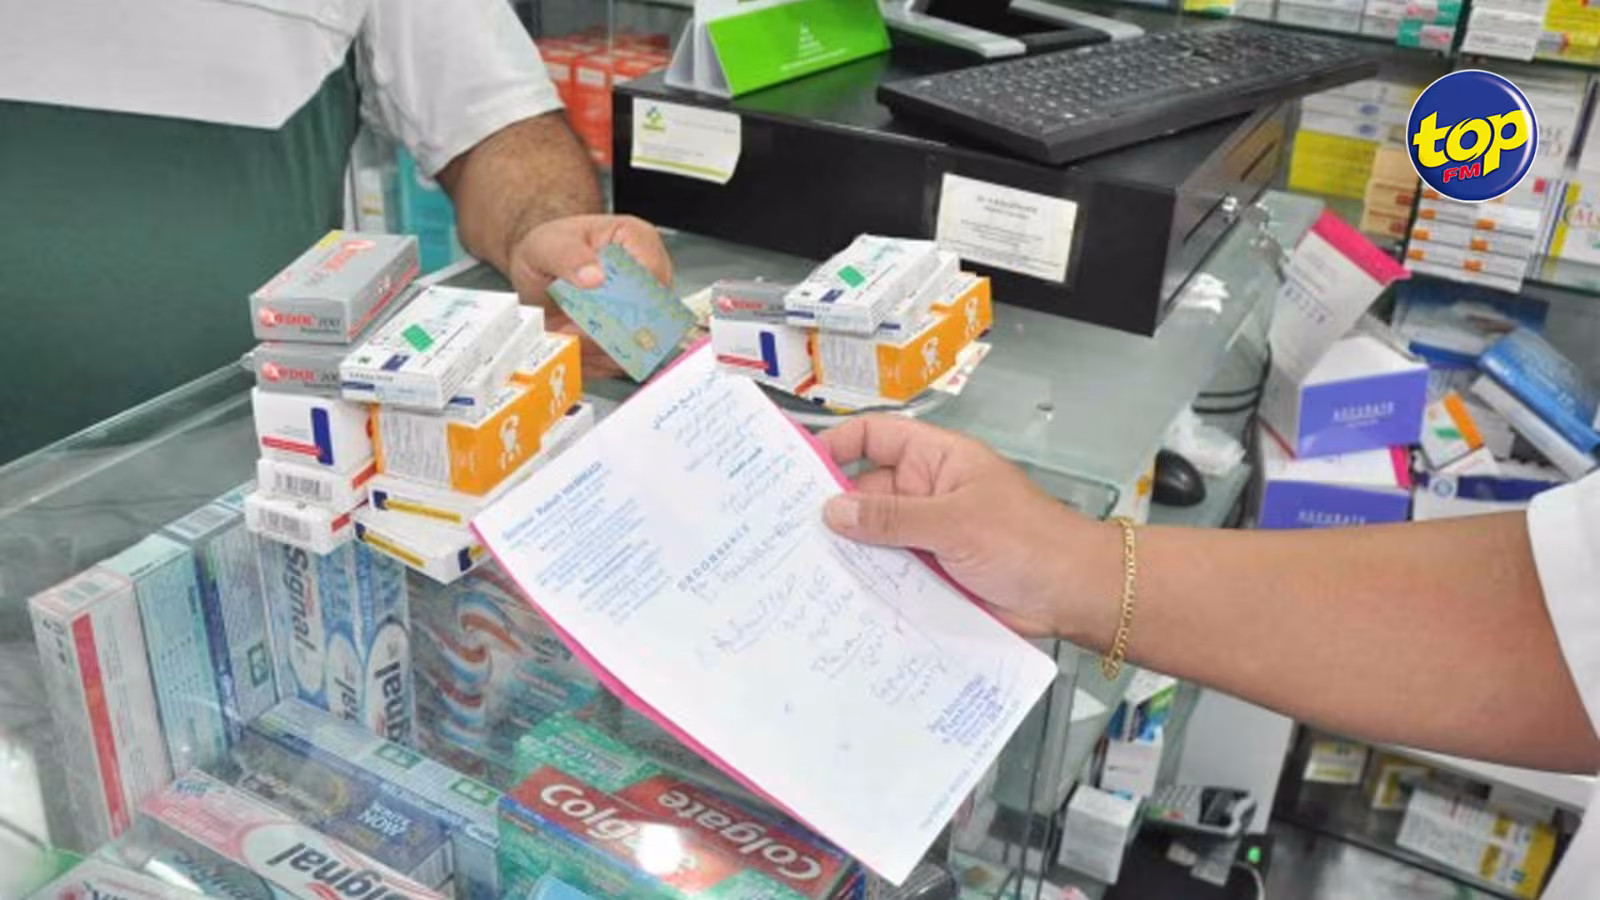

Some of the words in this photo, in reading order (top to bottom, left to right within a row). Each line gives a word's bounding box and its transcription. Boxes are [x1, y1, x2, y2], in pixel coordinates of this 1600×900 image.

[1333, 401, 1395, 422] ACCURATE
[655, 788, 822, 881] Colgate
[265, 842, 409, 900] ignal
